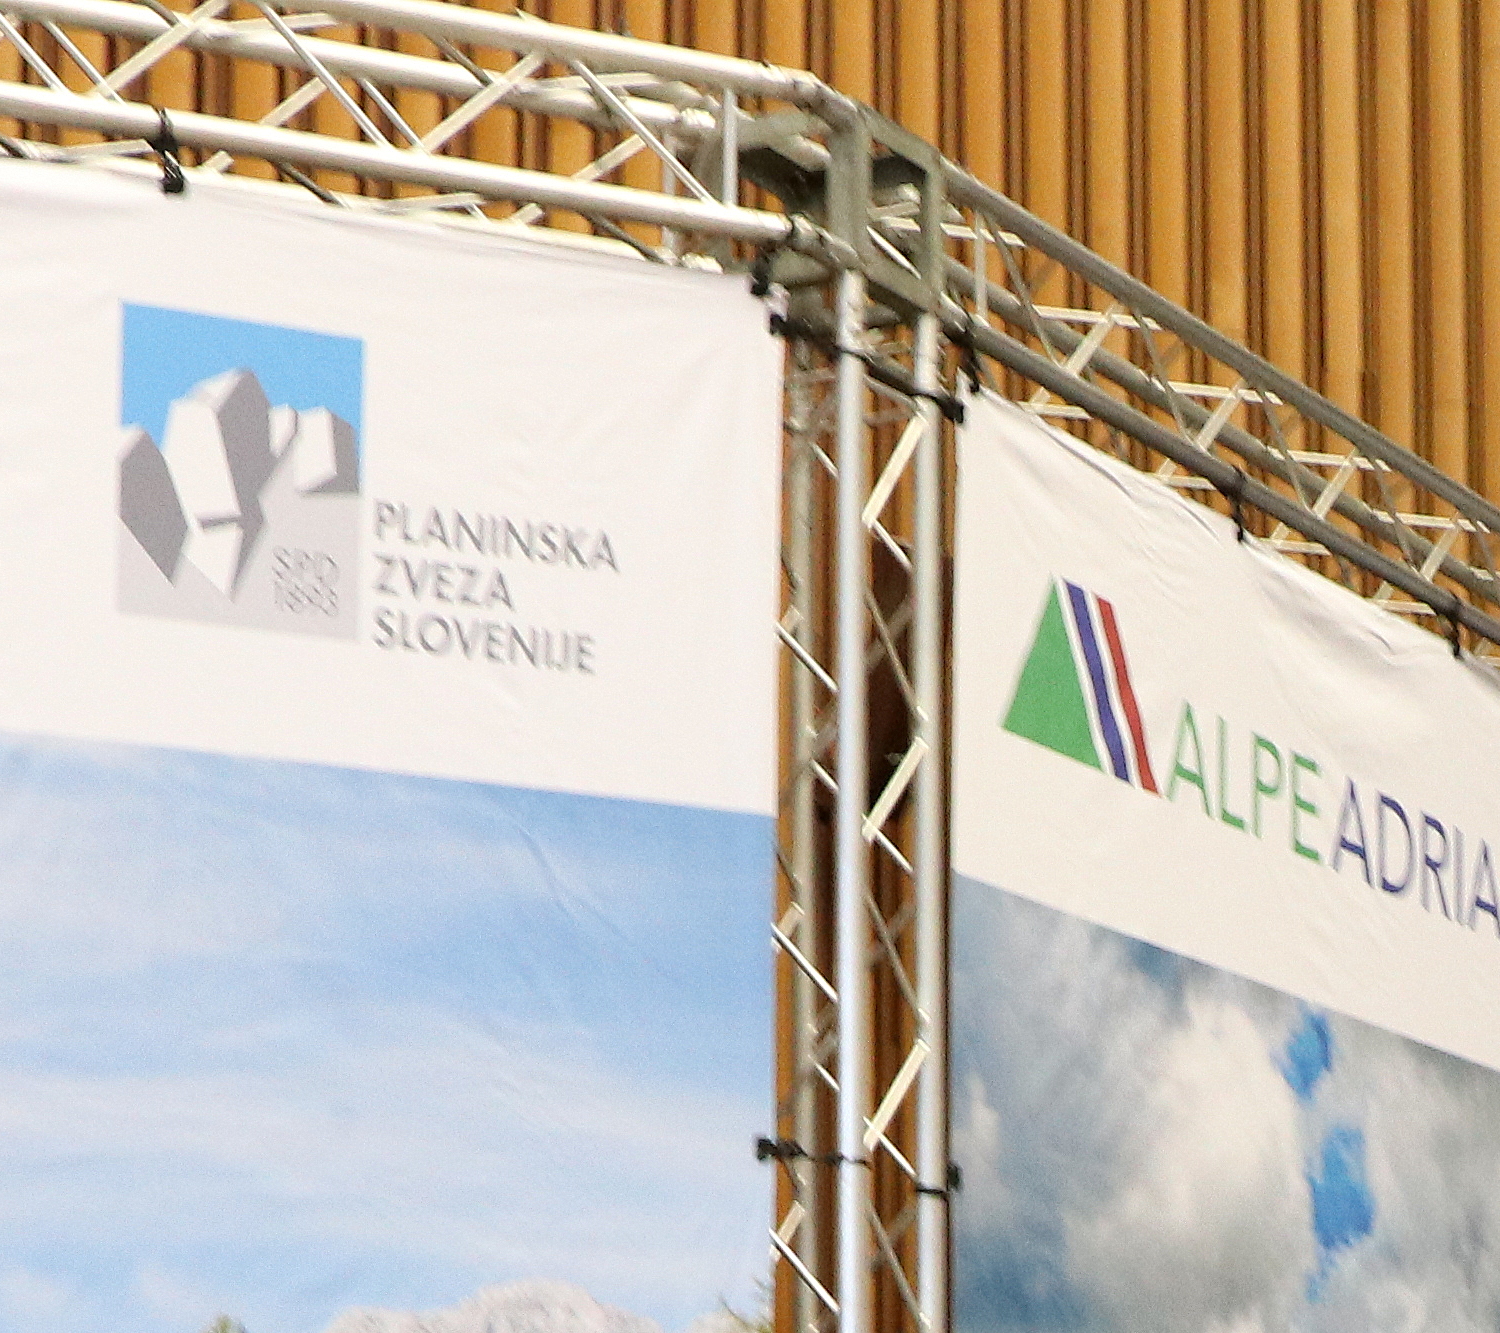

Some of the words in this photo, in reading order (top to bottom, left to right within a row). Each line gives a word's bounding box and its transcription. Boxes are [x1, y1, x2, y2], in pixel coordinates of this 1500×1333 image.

[372, 497, 621, 575] PLANINSKA
[372, 551, 516, 612] ZVEZA
[372, 605, 598, 676] SLOVENIJE
